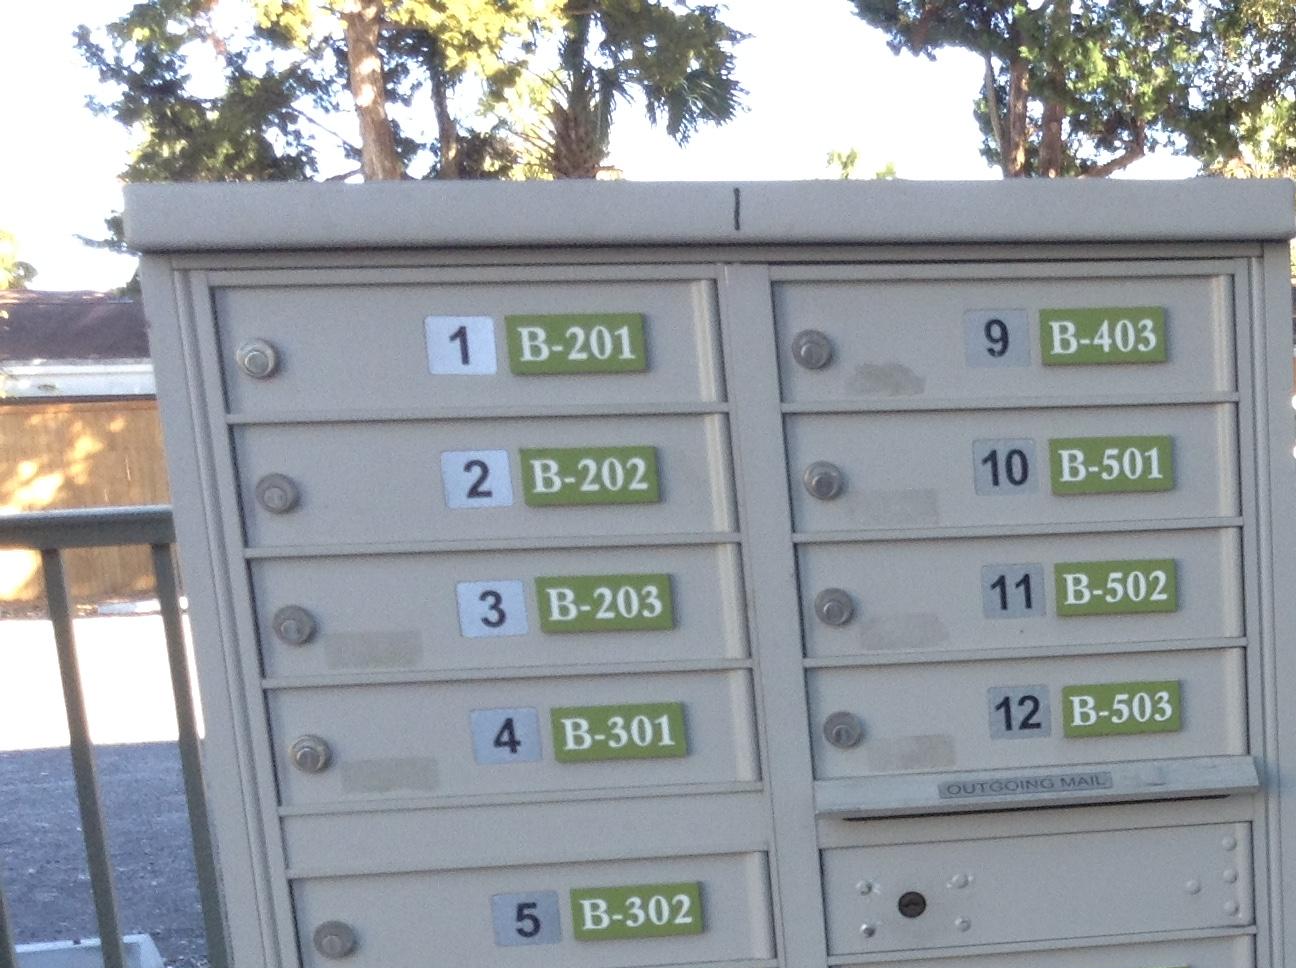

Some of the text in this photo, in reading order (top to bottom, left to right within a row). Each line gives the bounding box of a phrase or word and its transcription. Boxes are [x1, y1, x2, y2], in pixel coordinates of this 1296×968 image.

[449, 325, 470, 366] 1
[517, 325, 635, 361] B-201
[984, 318, 1010, 357] 9
[1049, 318, 1157, 355] B-403
[463, 459, 493, 499] 2
[530, 457, 649, 493] B-202
[981, 448, 1029, 487] 10
[1058, 447, 1163, 482] B-501
[546, 585, 663, 621] B-203
[990, 573, 1033, 611] 11
[1063, 570, 1168, 605] B-502
[479, 589, 507, 629] 3
[995, 694, 1042, 731] 12
[1069, 691, 1173, 726] B-503
[493, 717, 522, 754] 4
[560, 714, 675, 750] B-301
[946, 775, 1106, 796] OUTGOING MAIL
[515, 901, 541, 938] 5
[579, 894, 693, 930] B-302
